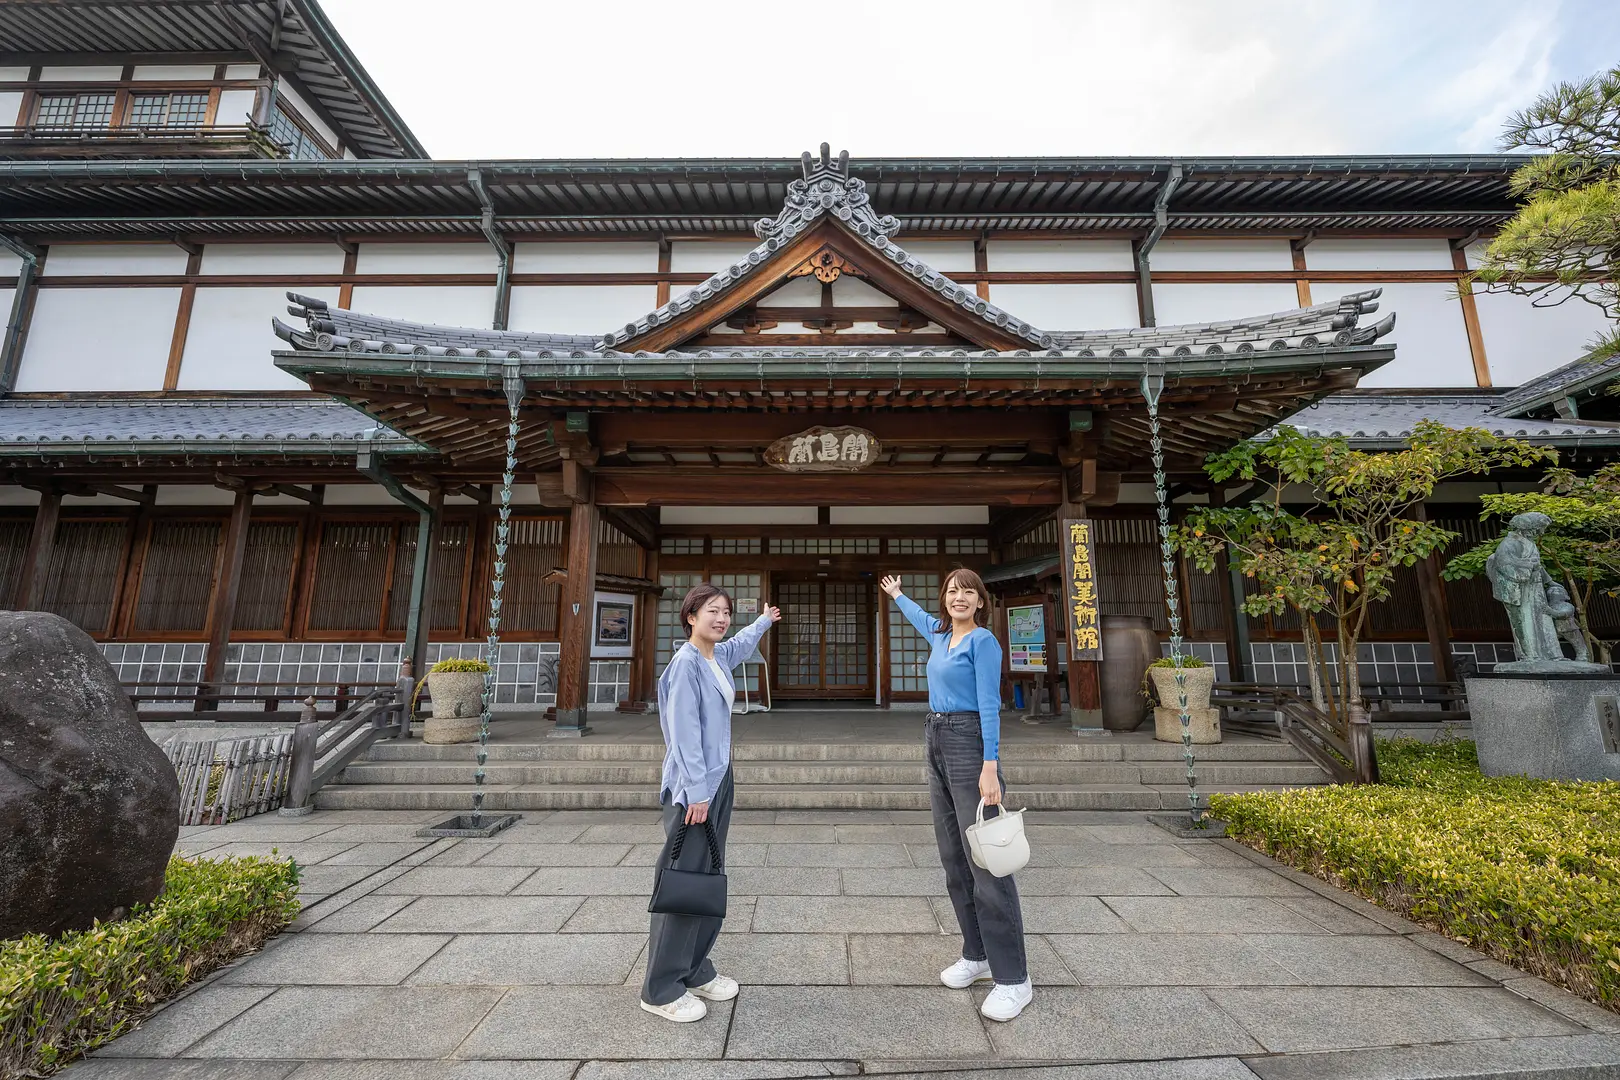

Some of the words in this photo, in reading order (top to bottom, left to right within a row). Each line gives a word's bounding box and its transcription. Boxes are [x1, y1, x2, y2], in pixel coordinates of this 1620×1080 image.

[788, 433, 868, 463] 蘭島閣
[1070, 523, 1098, 650] 蘭島閣美術館
